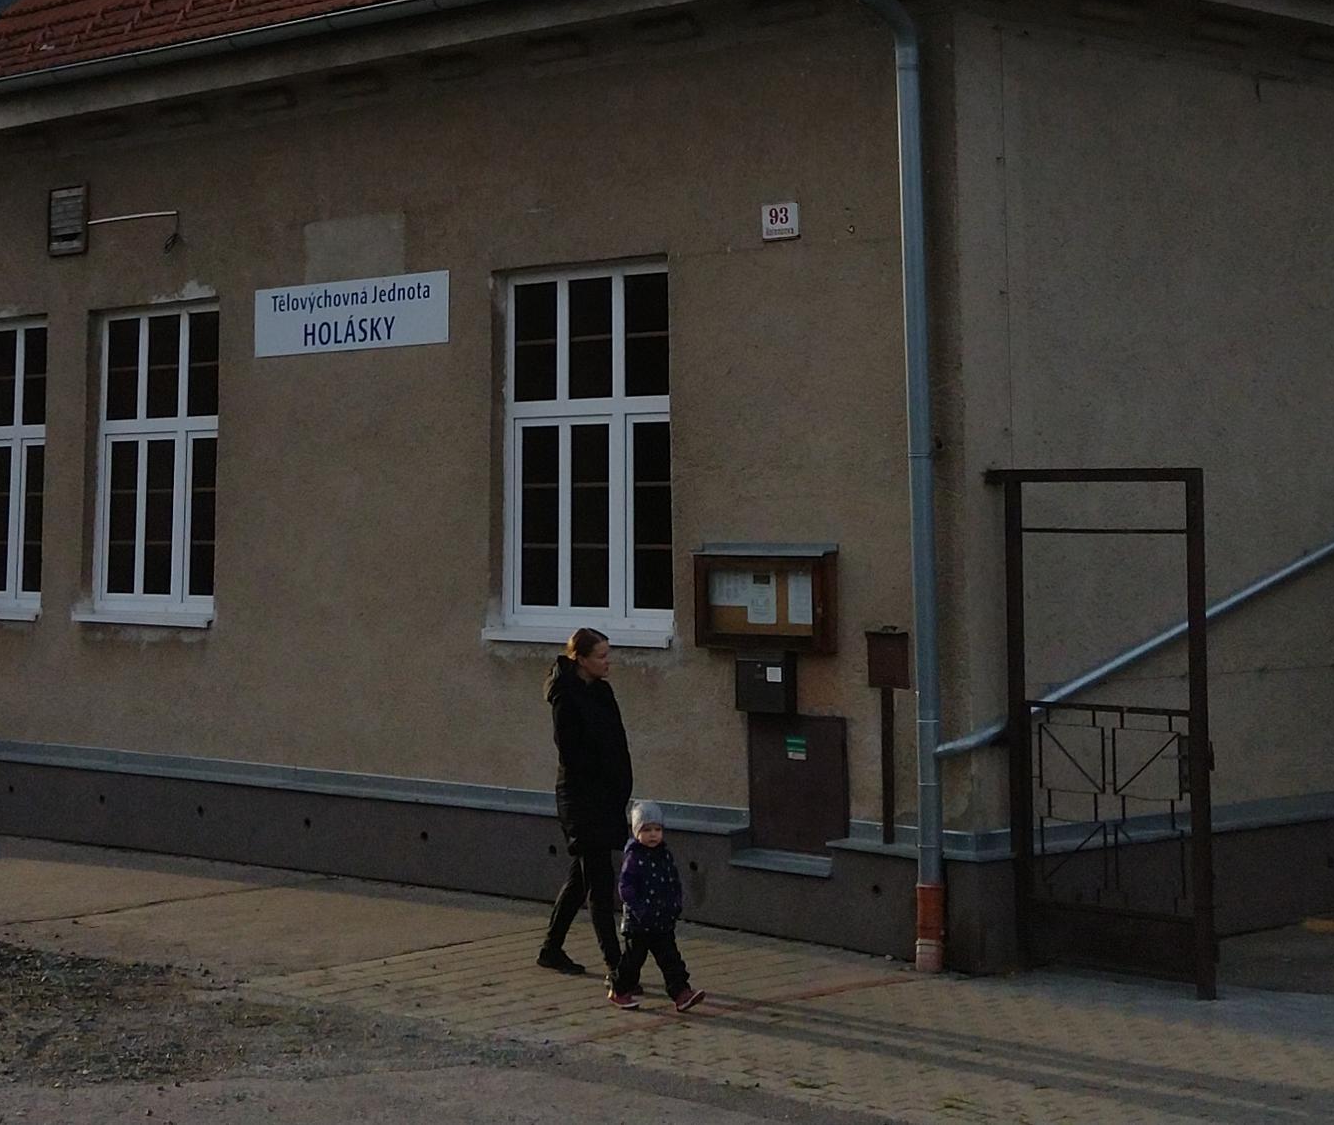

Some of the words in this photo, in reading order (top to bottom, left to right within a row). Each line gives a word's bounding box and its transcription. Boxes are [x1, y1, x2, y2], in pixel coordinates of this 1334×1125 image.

[769, 207, 789, 225] 93
[271, 288, 368, 315] Tělovýchovná
[371, 282, 431, 304] Jednota
[303, 315, 396, 347] HOLÁSKY
